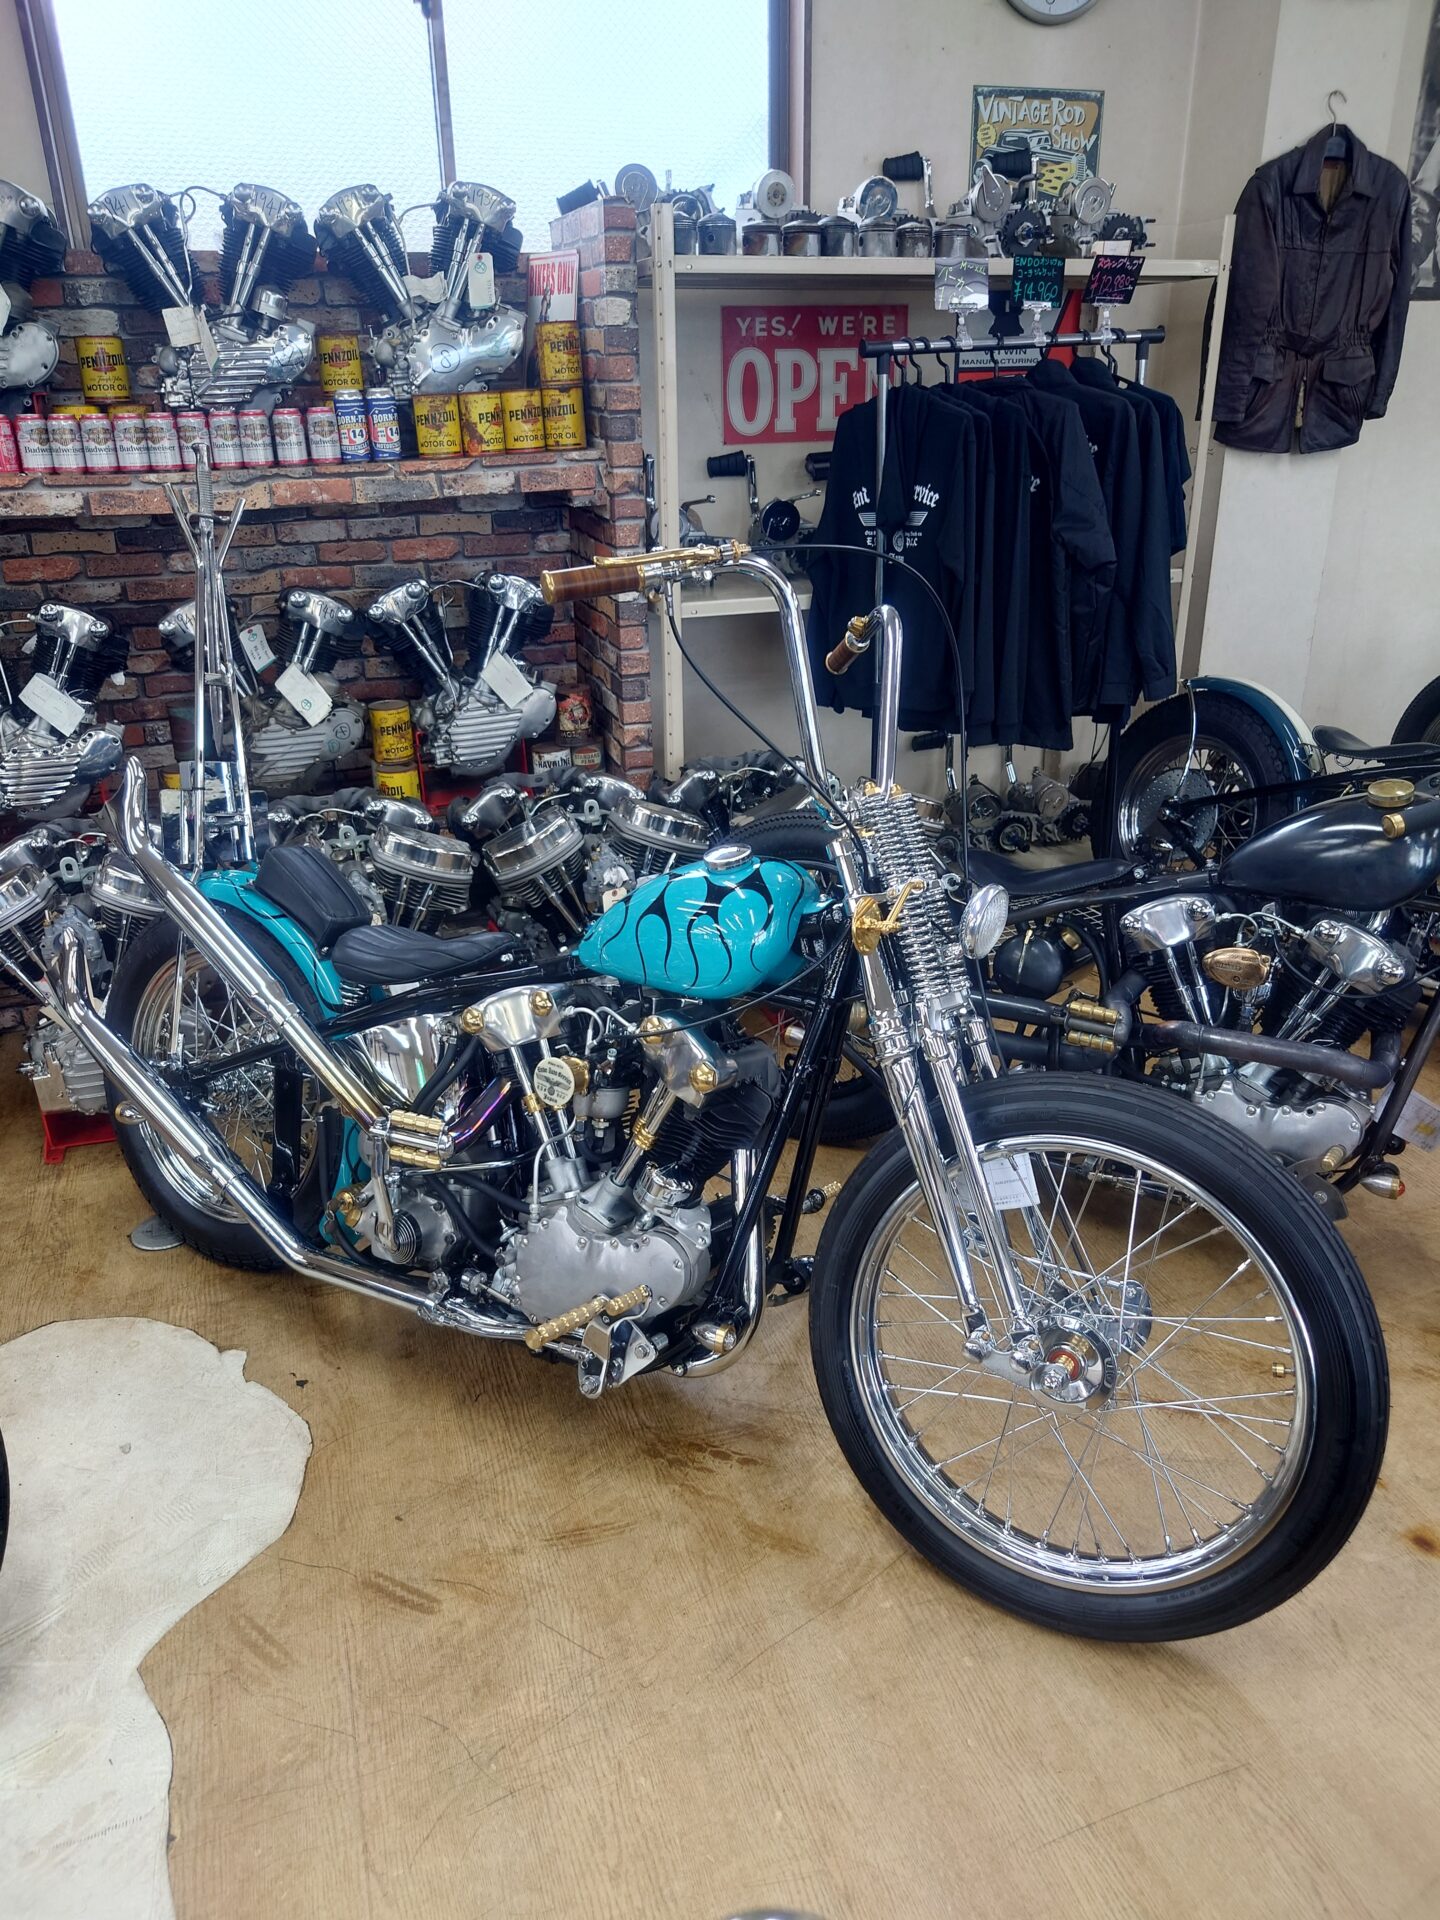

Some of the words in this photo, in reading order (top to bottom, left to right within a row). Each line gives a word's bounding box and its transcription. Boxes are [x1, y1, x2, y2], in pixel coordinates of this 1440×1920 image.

[977, 95, 1051, 125] VINTAGE
[1051, 97, 1085, 126] ROD
[1052, 125, 1098, 151] SHOW
[530, 261, 556, 297] BIKERS
[557, 260, 576, 296] ONLY
[736, 313, 802, 337] YES!
[818, 313, 896, 336] WE'RE
[80, 353, 125, 369] PENNZOIL
[319, 349, 358, 364] PENNZOIL
[117, 383, 128, 391] OIL
[324, 378, 349, 386] MOTOR
[416, 410, 456, 426] PENNZOIL
[351, 429, 364, 438] 14
[388, 427, 399, 437] 14
[513, 434, 538, 442] MOTOR
[565, 431, 577, 439] OIL
[420, 440, 445, 448] MOTOR
[446, 439, 457, 447] OIL
[913, 483, 939, 508] rvice
[384, 744, 409, 755] MOTOR
